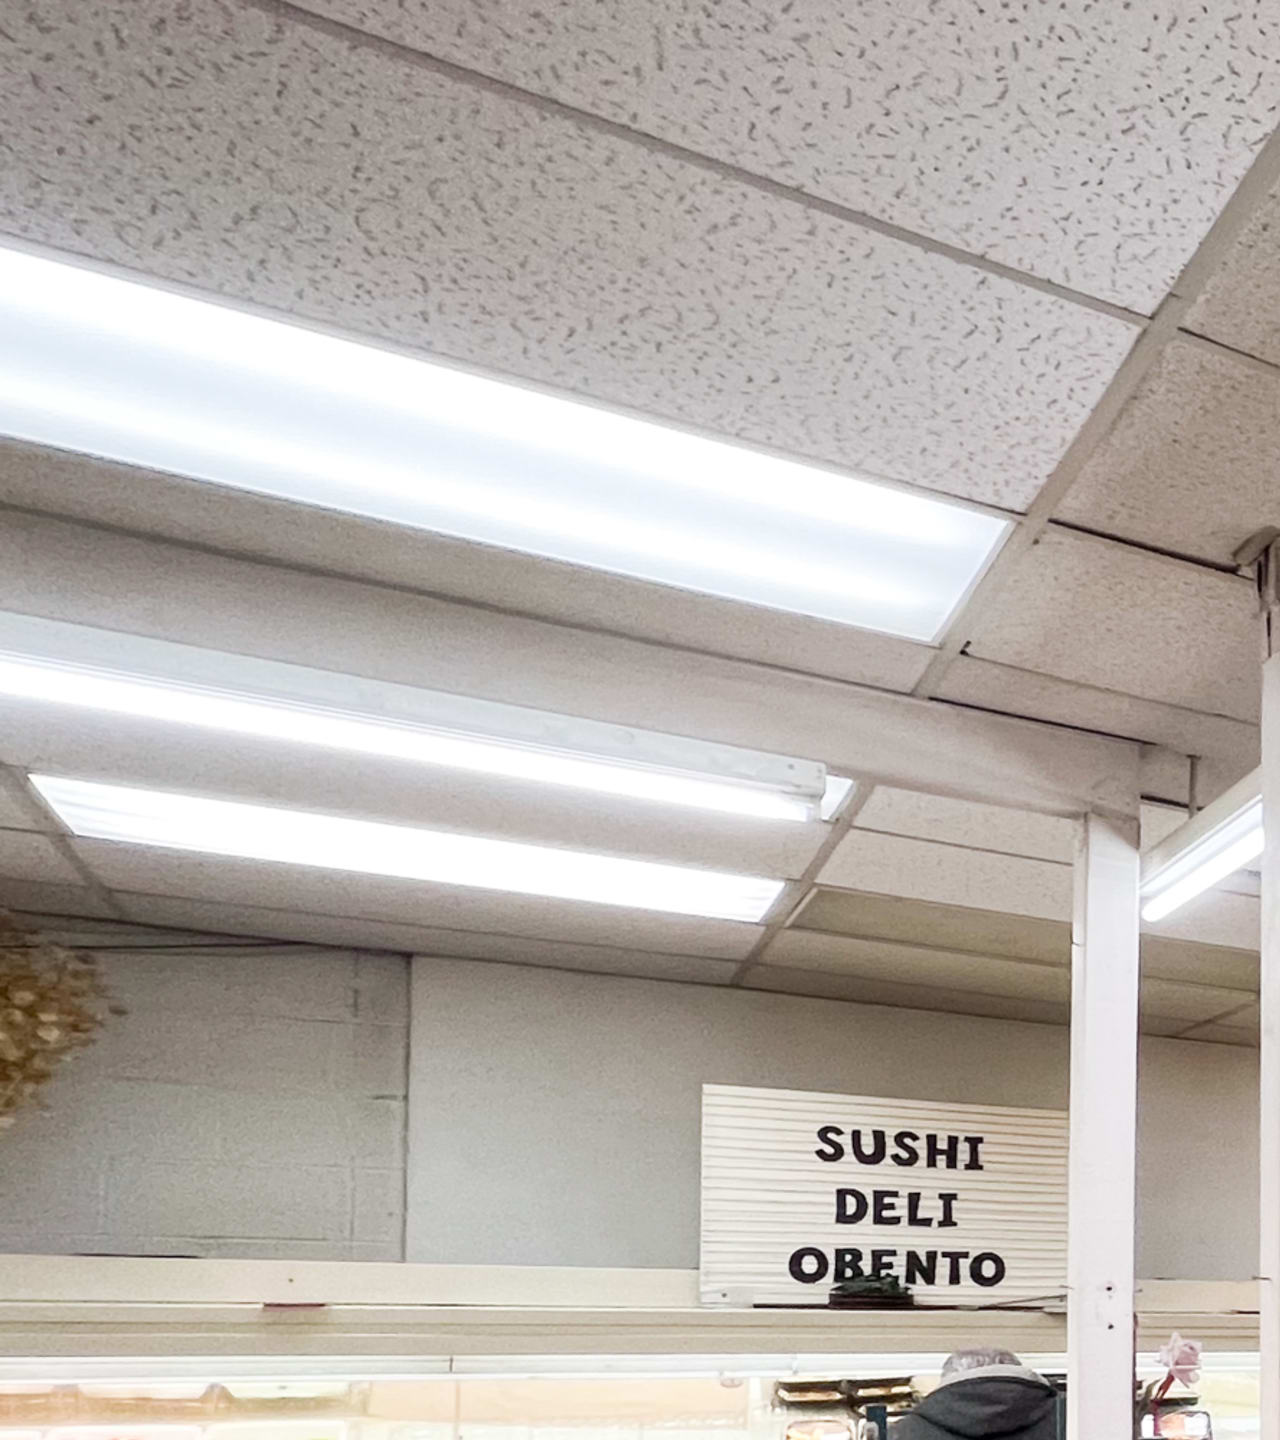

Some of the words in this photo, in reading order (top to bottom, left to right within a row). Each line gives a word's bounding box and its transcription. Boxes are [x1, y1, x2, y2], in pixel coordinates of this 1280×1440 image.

[815, 1126, 984, 1170] SUSHI
[835, 1188, 958, 1227] DELI
[788, 1247, 1006, 1287] OBENTO
